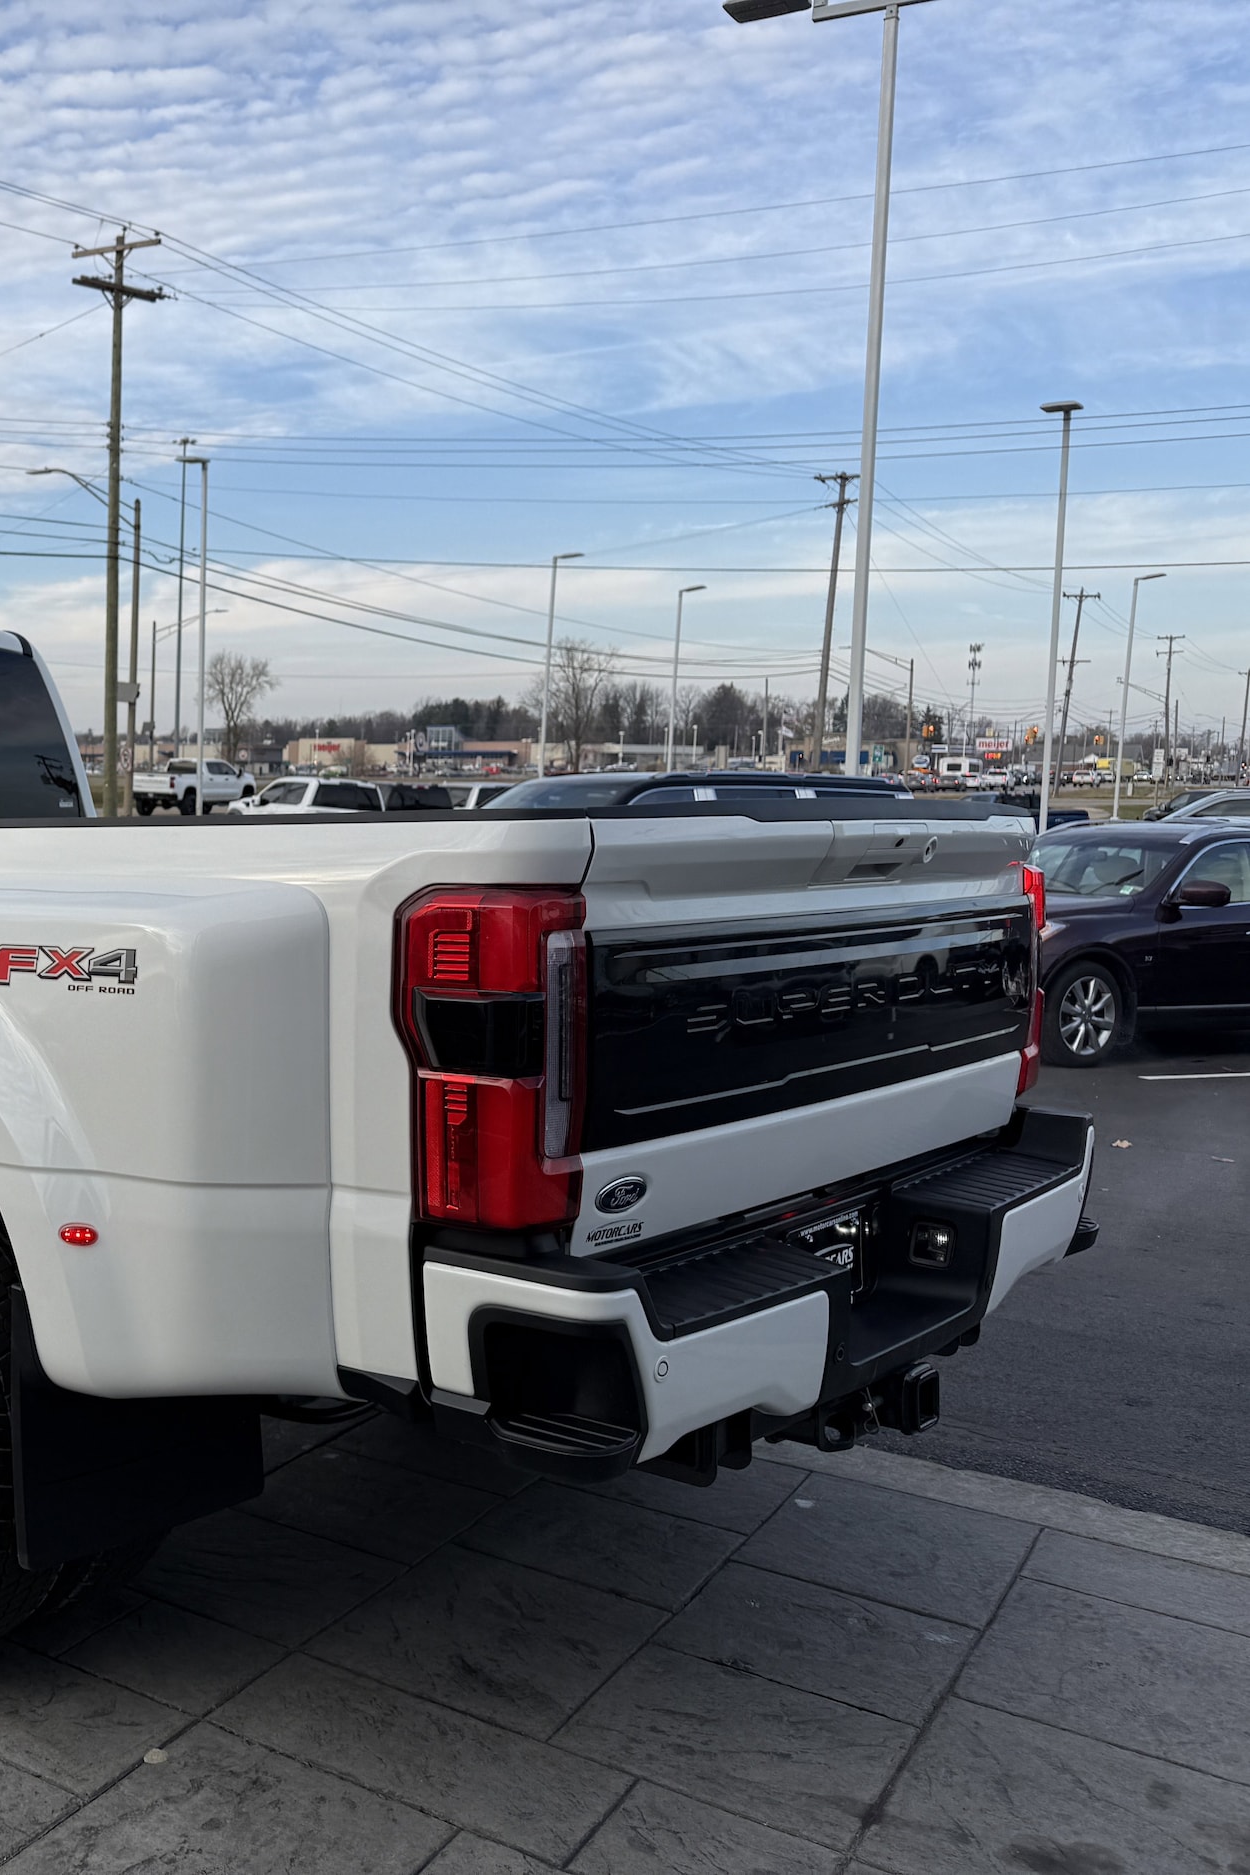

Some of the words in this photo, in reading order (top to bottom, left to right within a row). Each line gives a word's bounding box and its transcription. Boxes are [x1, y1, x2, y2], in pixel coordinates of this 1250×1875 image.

[978, 739, 1010, 750] meijer
[67, 984, 94, 993] OFF
[98, 986, 136, 996] ROAD
[686, 982, 886, 1034] SUPER
[585, 1221, 645, 1243] MOTORCARS
